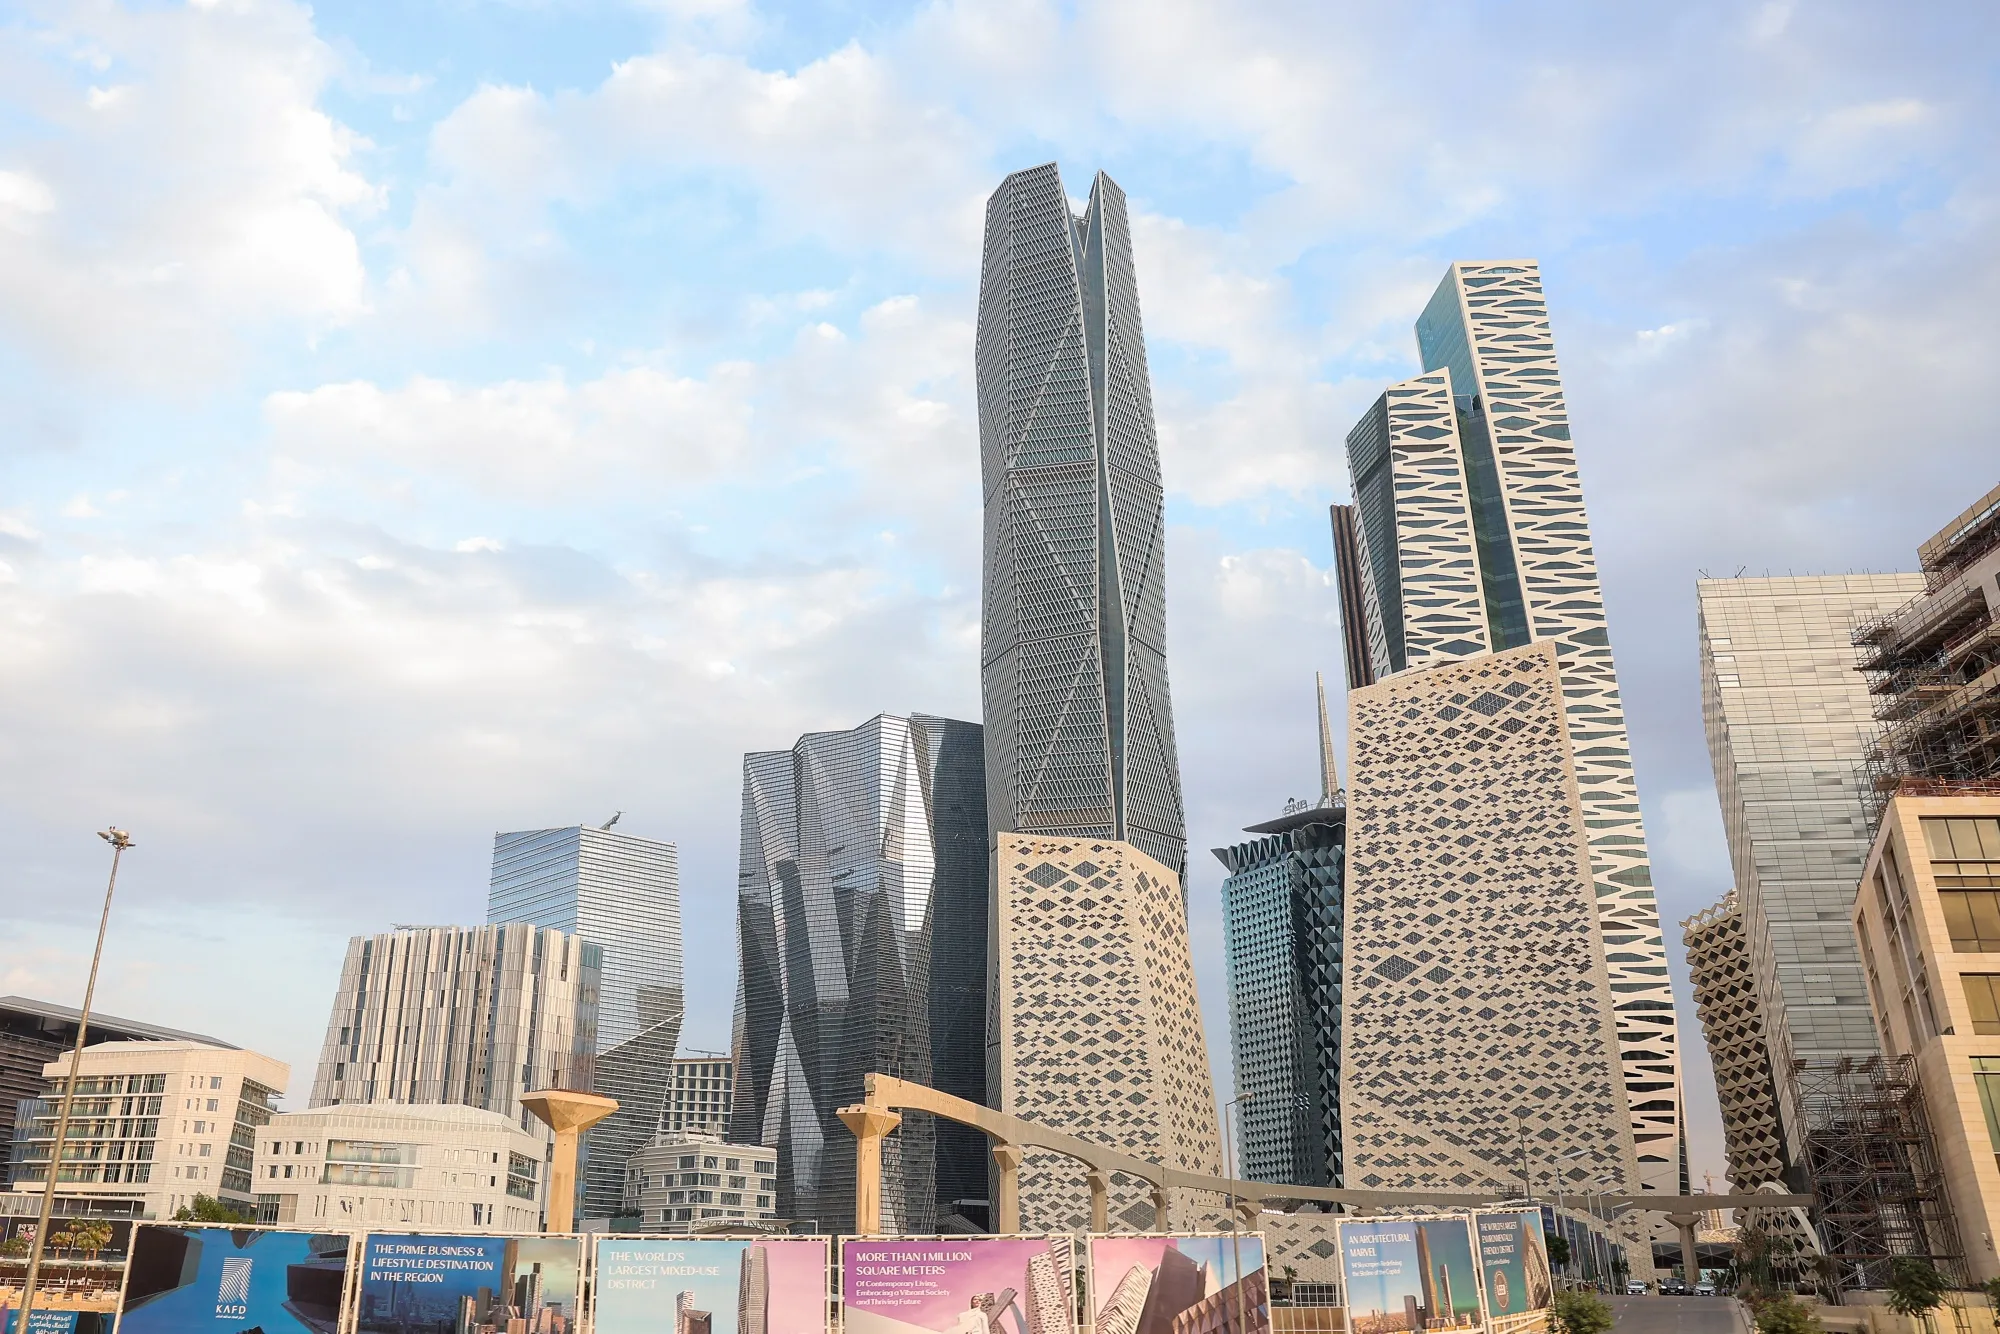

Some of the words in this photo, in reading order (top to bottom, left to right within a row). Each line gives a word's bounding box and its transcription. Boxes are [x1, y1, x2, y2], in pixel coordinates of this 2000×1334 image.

[1349, 1235, 1358, 1244] AN
[1359, 1233, 1411, 1244] ARCHITECTURAL
[375, 1244, 395, 1254] THE
[396, 1244, 427, 1255] PRIME
[428, 1246, 475, 1256] BUSINESS
[477, 1247, 484, 1256] &
[1350, 1247, 1377, 1257] MARVEL
[610, 1252, 631, 1261] THE
[633, 1252, 685, 1261] WORLD'S
[856, 1252, 888, 1261] MORE
[890, 1252, 920, 1261] THAN
[922, 1252, 927, 1261] 1
[928, 1252, 972, 1261] MILLION
[372, 1258, 425, 1269] LIFESTYLE
[426, 1259, 494, 1271] DESTINATION
[608, 1265, 658, 1275] LARGEST
[660, 1266, 719, 1276] MIXED-USE
[856, 1266, 900, 1276] SQUARE
[902, 1265, 946, 1275] METERS
[371, 1271, 382, 1281] IN
[383, 1271, 403, 1282] THE
[404, 1272, 444, 1282] REGION
[608, 1279, 656, 1289] DISTRICT
[866, 1280, 914, 1288] Contemporary
[915, 1280, 938, 1288] Living,
[856, 1289, 893, 1298] Embracing
[925, 1289, 950, 1297] Society
[871, 1298, 898, 1306] Thriving
[215, 1304, 246, 1314] KAFD
